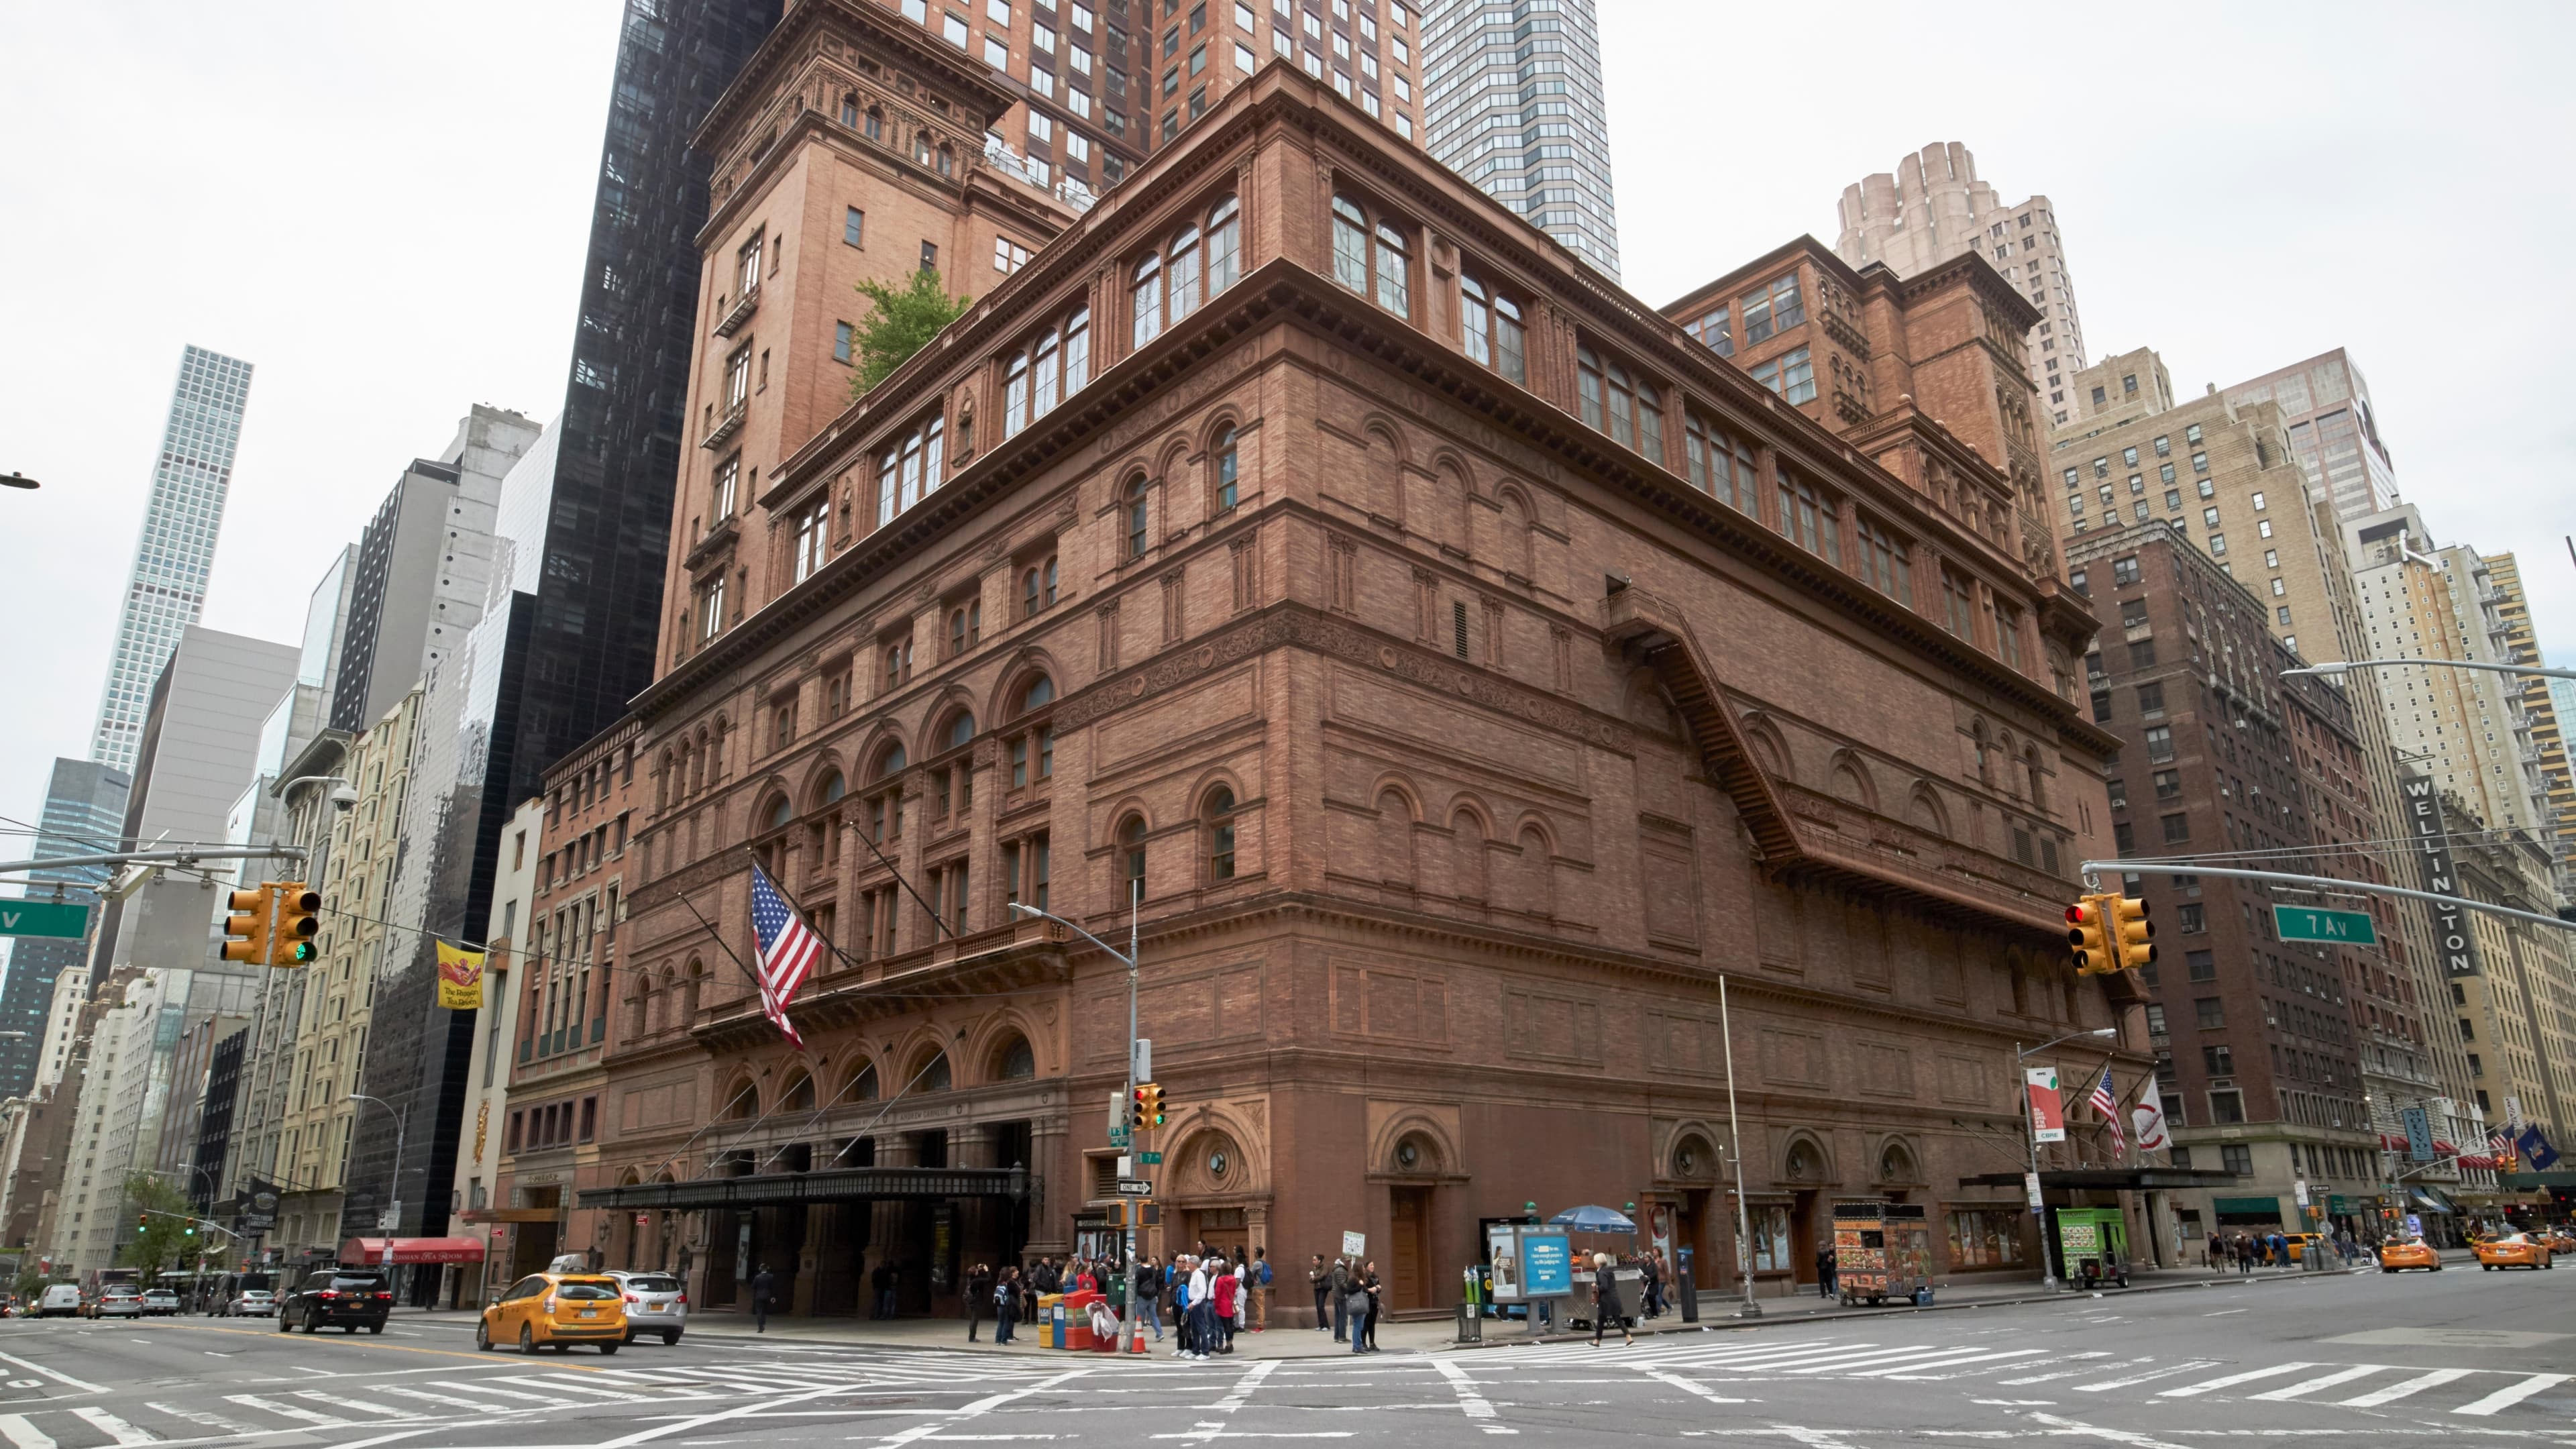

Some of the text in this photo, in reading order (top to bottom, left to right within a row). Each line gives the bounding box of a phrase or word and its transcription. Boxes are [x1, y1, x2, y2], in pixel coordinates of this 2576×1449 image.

[2306, 914, 2317, 934] 7
[444, 987, 455, 996] The
[447, 997, 458, 1005] Tea
[1148, 1154, 1152, 1162] 7
[438, 1252, 462, 1260] ROOM
